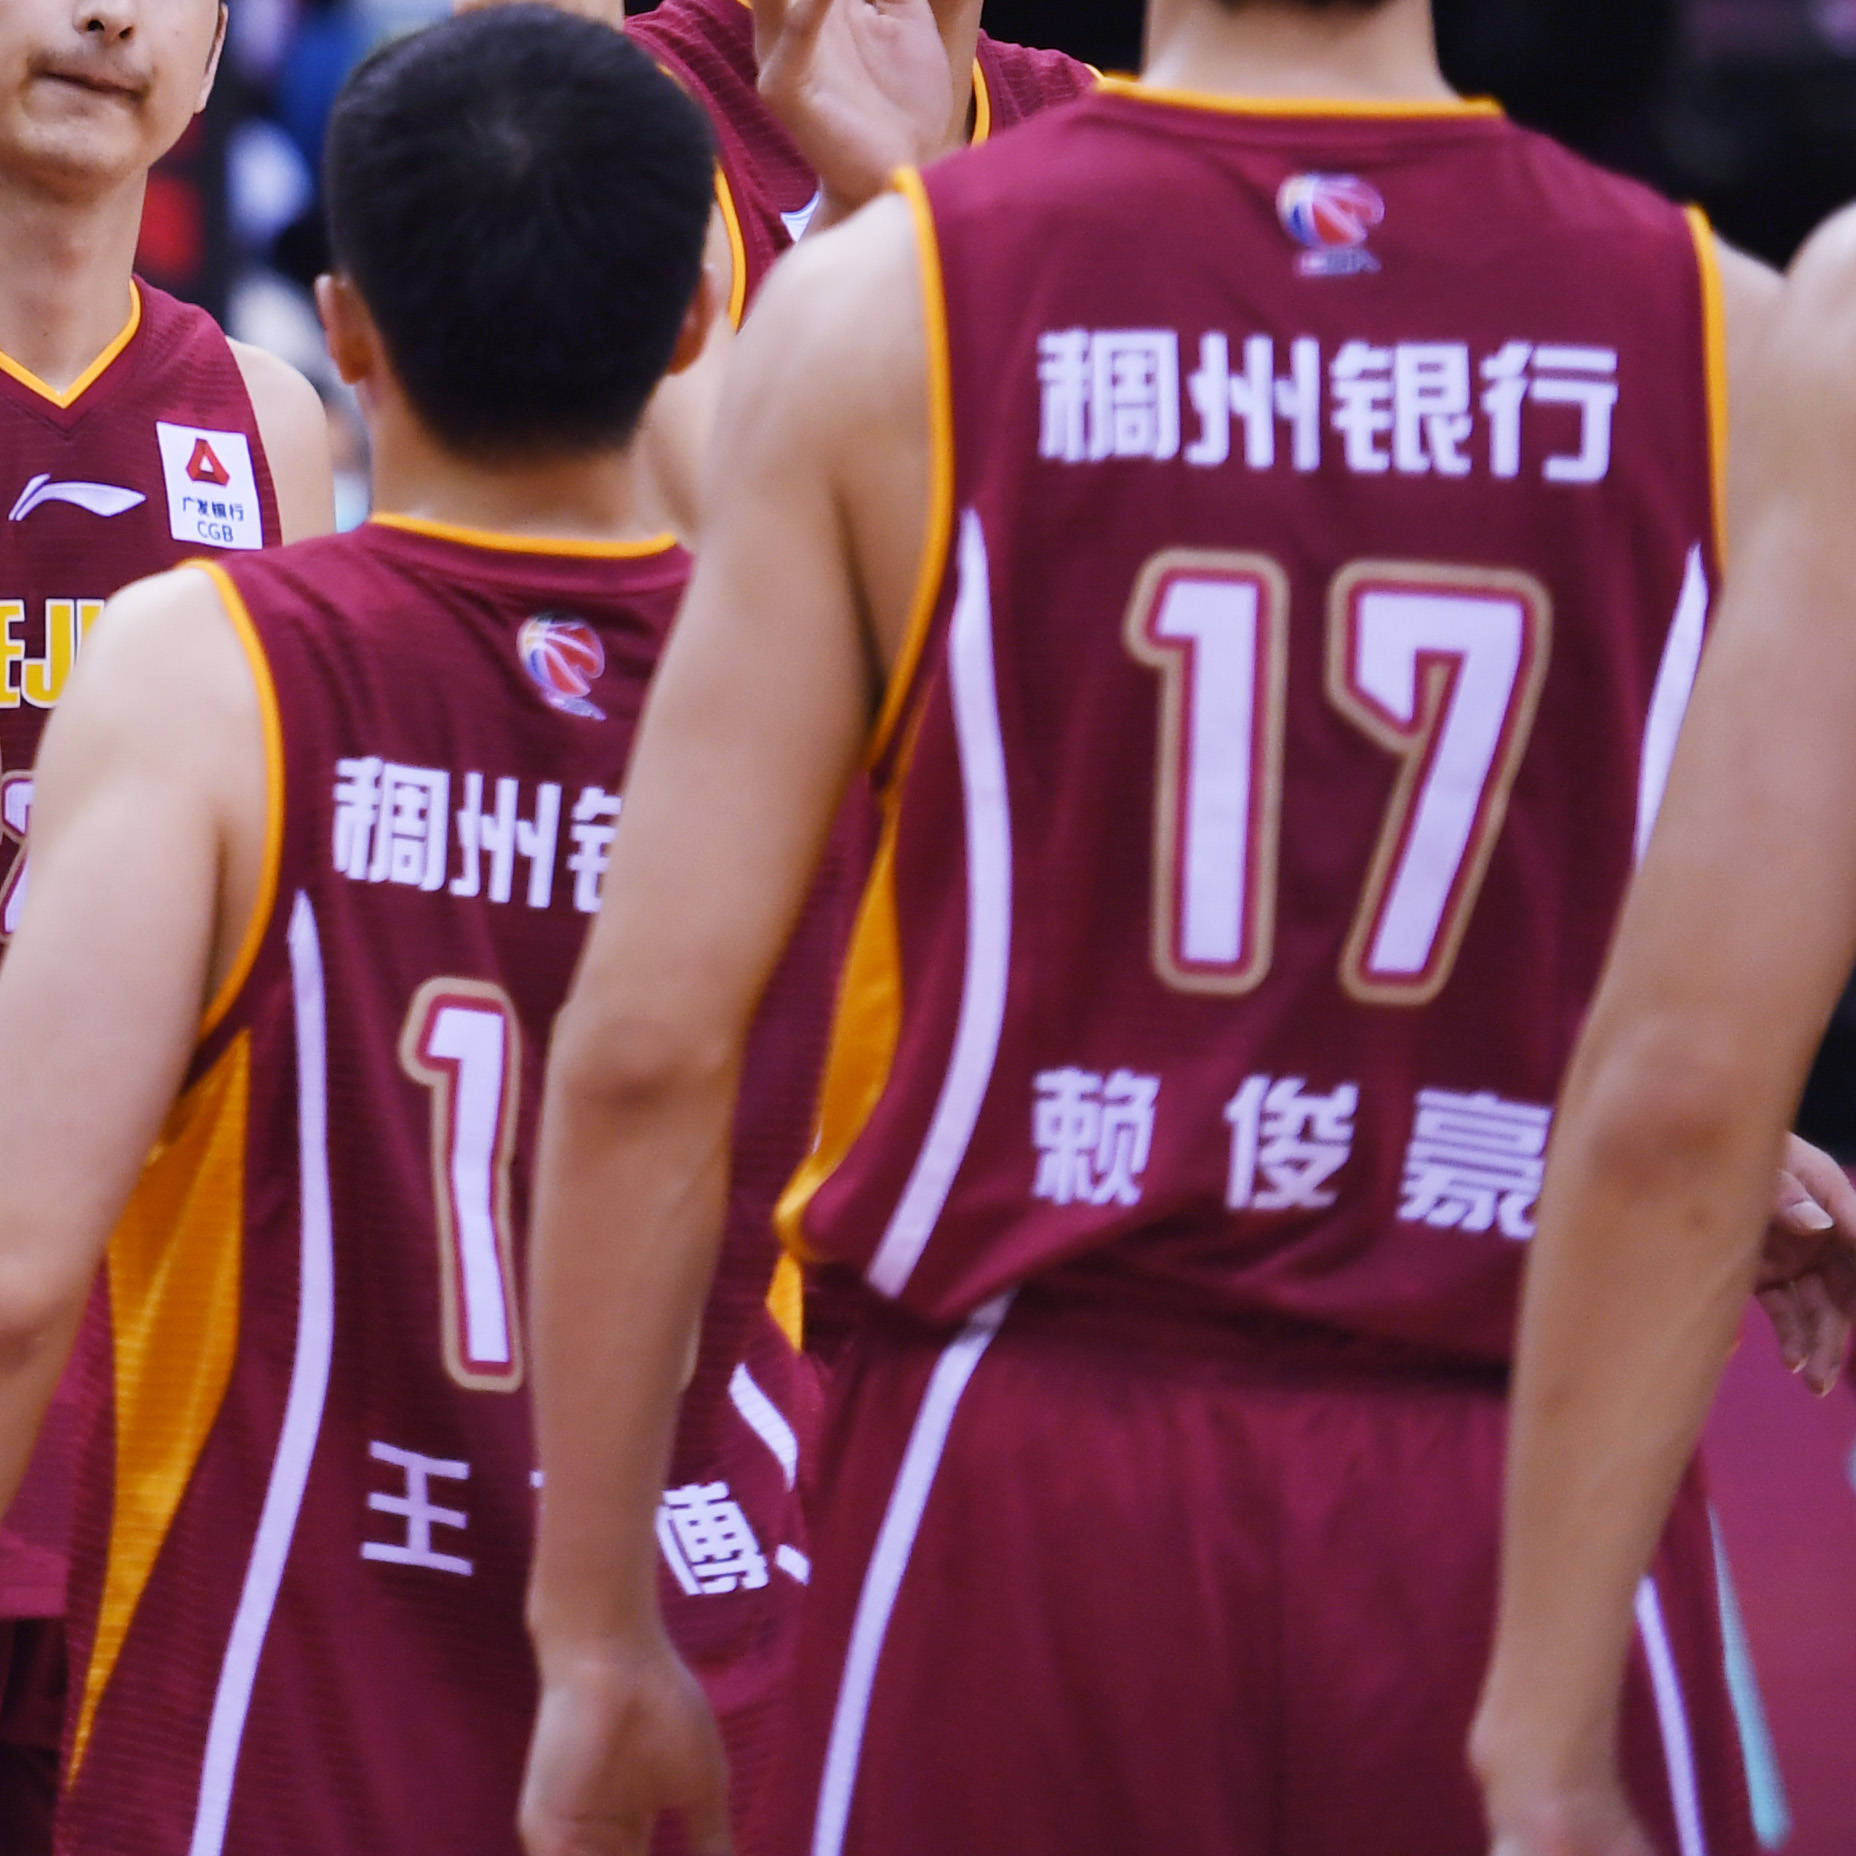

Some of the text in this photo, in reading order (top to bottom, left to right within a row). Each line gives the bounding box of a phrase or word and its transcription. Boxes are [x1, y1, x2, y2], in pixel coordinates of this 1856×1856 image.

[1038, 327, 1618, 484] 稠州银行
[197, 520, 233, 542] CGB
[1128, 554, 1548, 1002] 17
[1031, 1066, 1554, 1240] 赖俊豪
